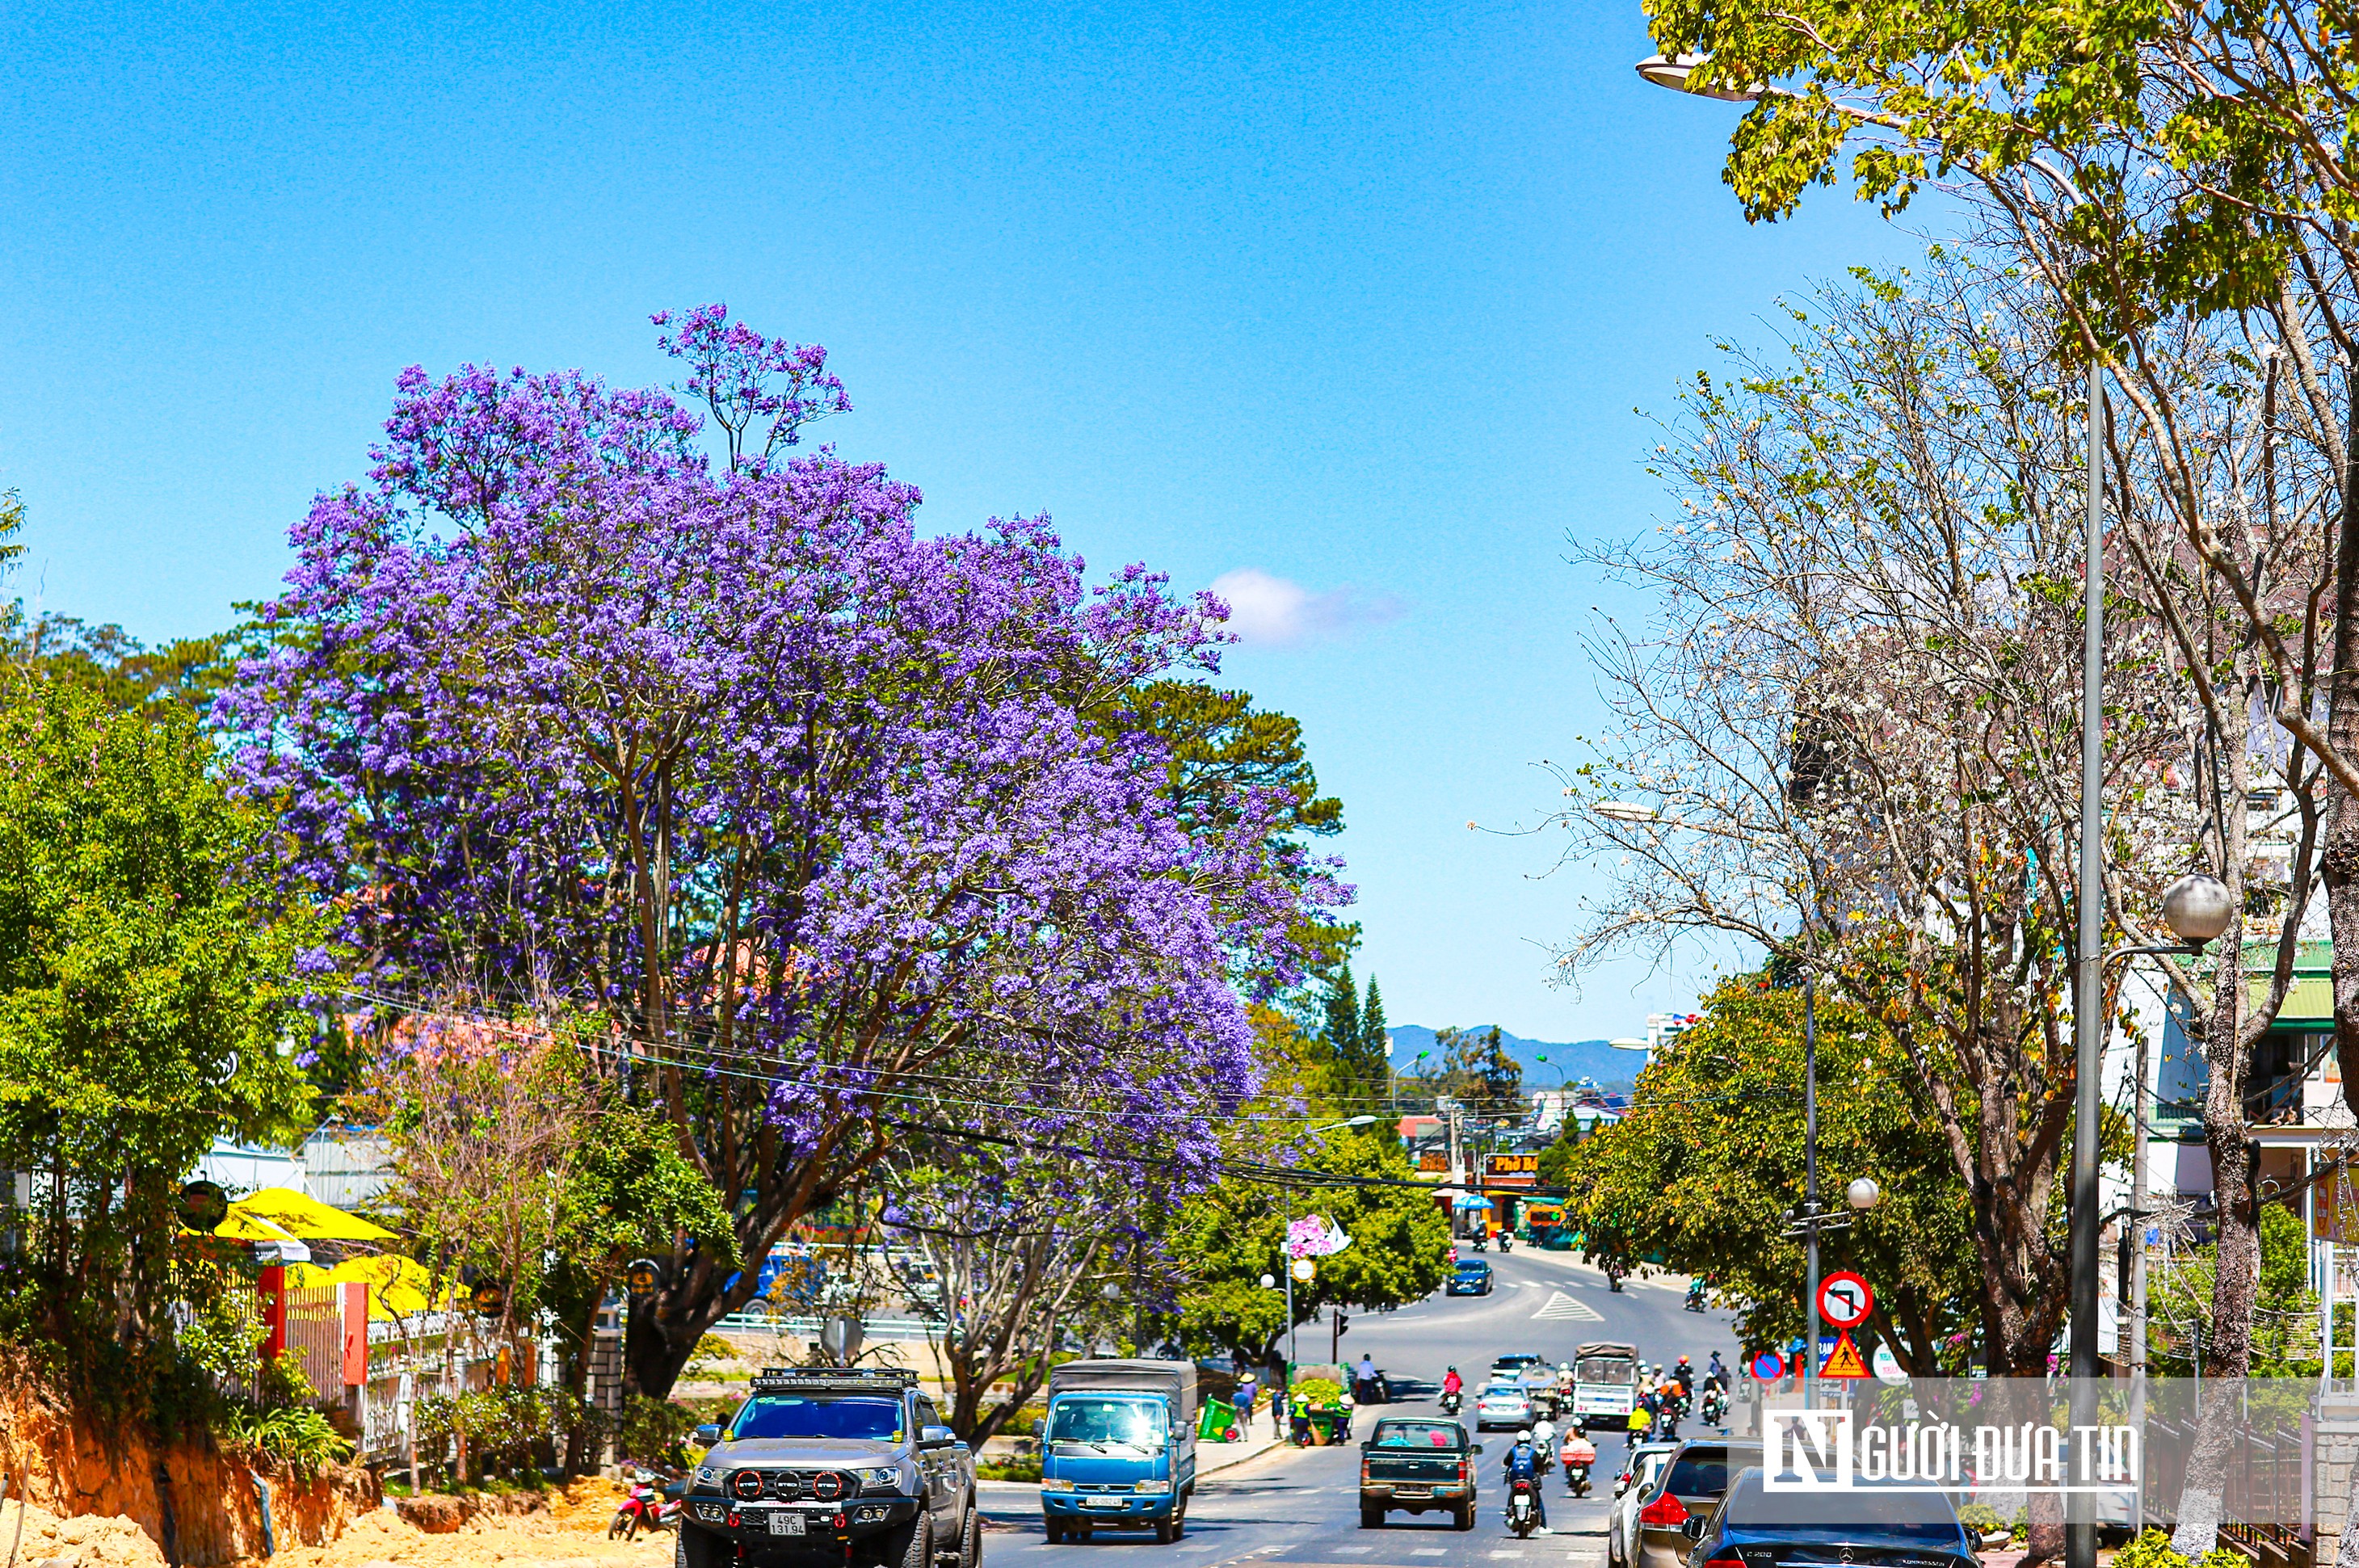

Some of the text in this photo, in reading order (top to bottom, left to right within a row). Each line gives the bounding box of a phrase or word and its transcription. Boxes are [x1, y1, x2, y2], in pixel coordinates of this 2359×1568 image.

[1495, 1154, 1521, 1171] Phở
[778, 1516, 796, 1524] 49C
[772, 1525, 805, 1534] 131.94
